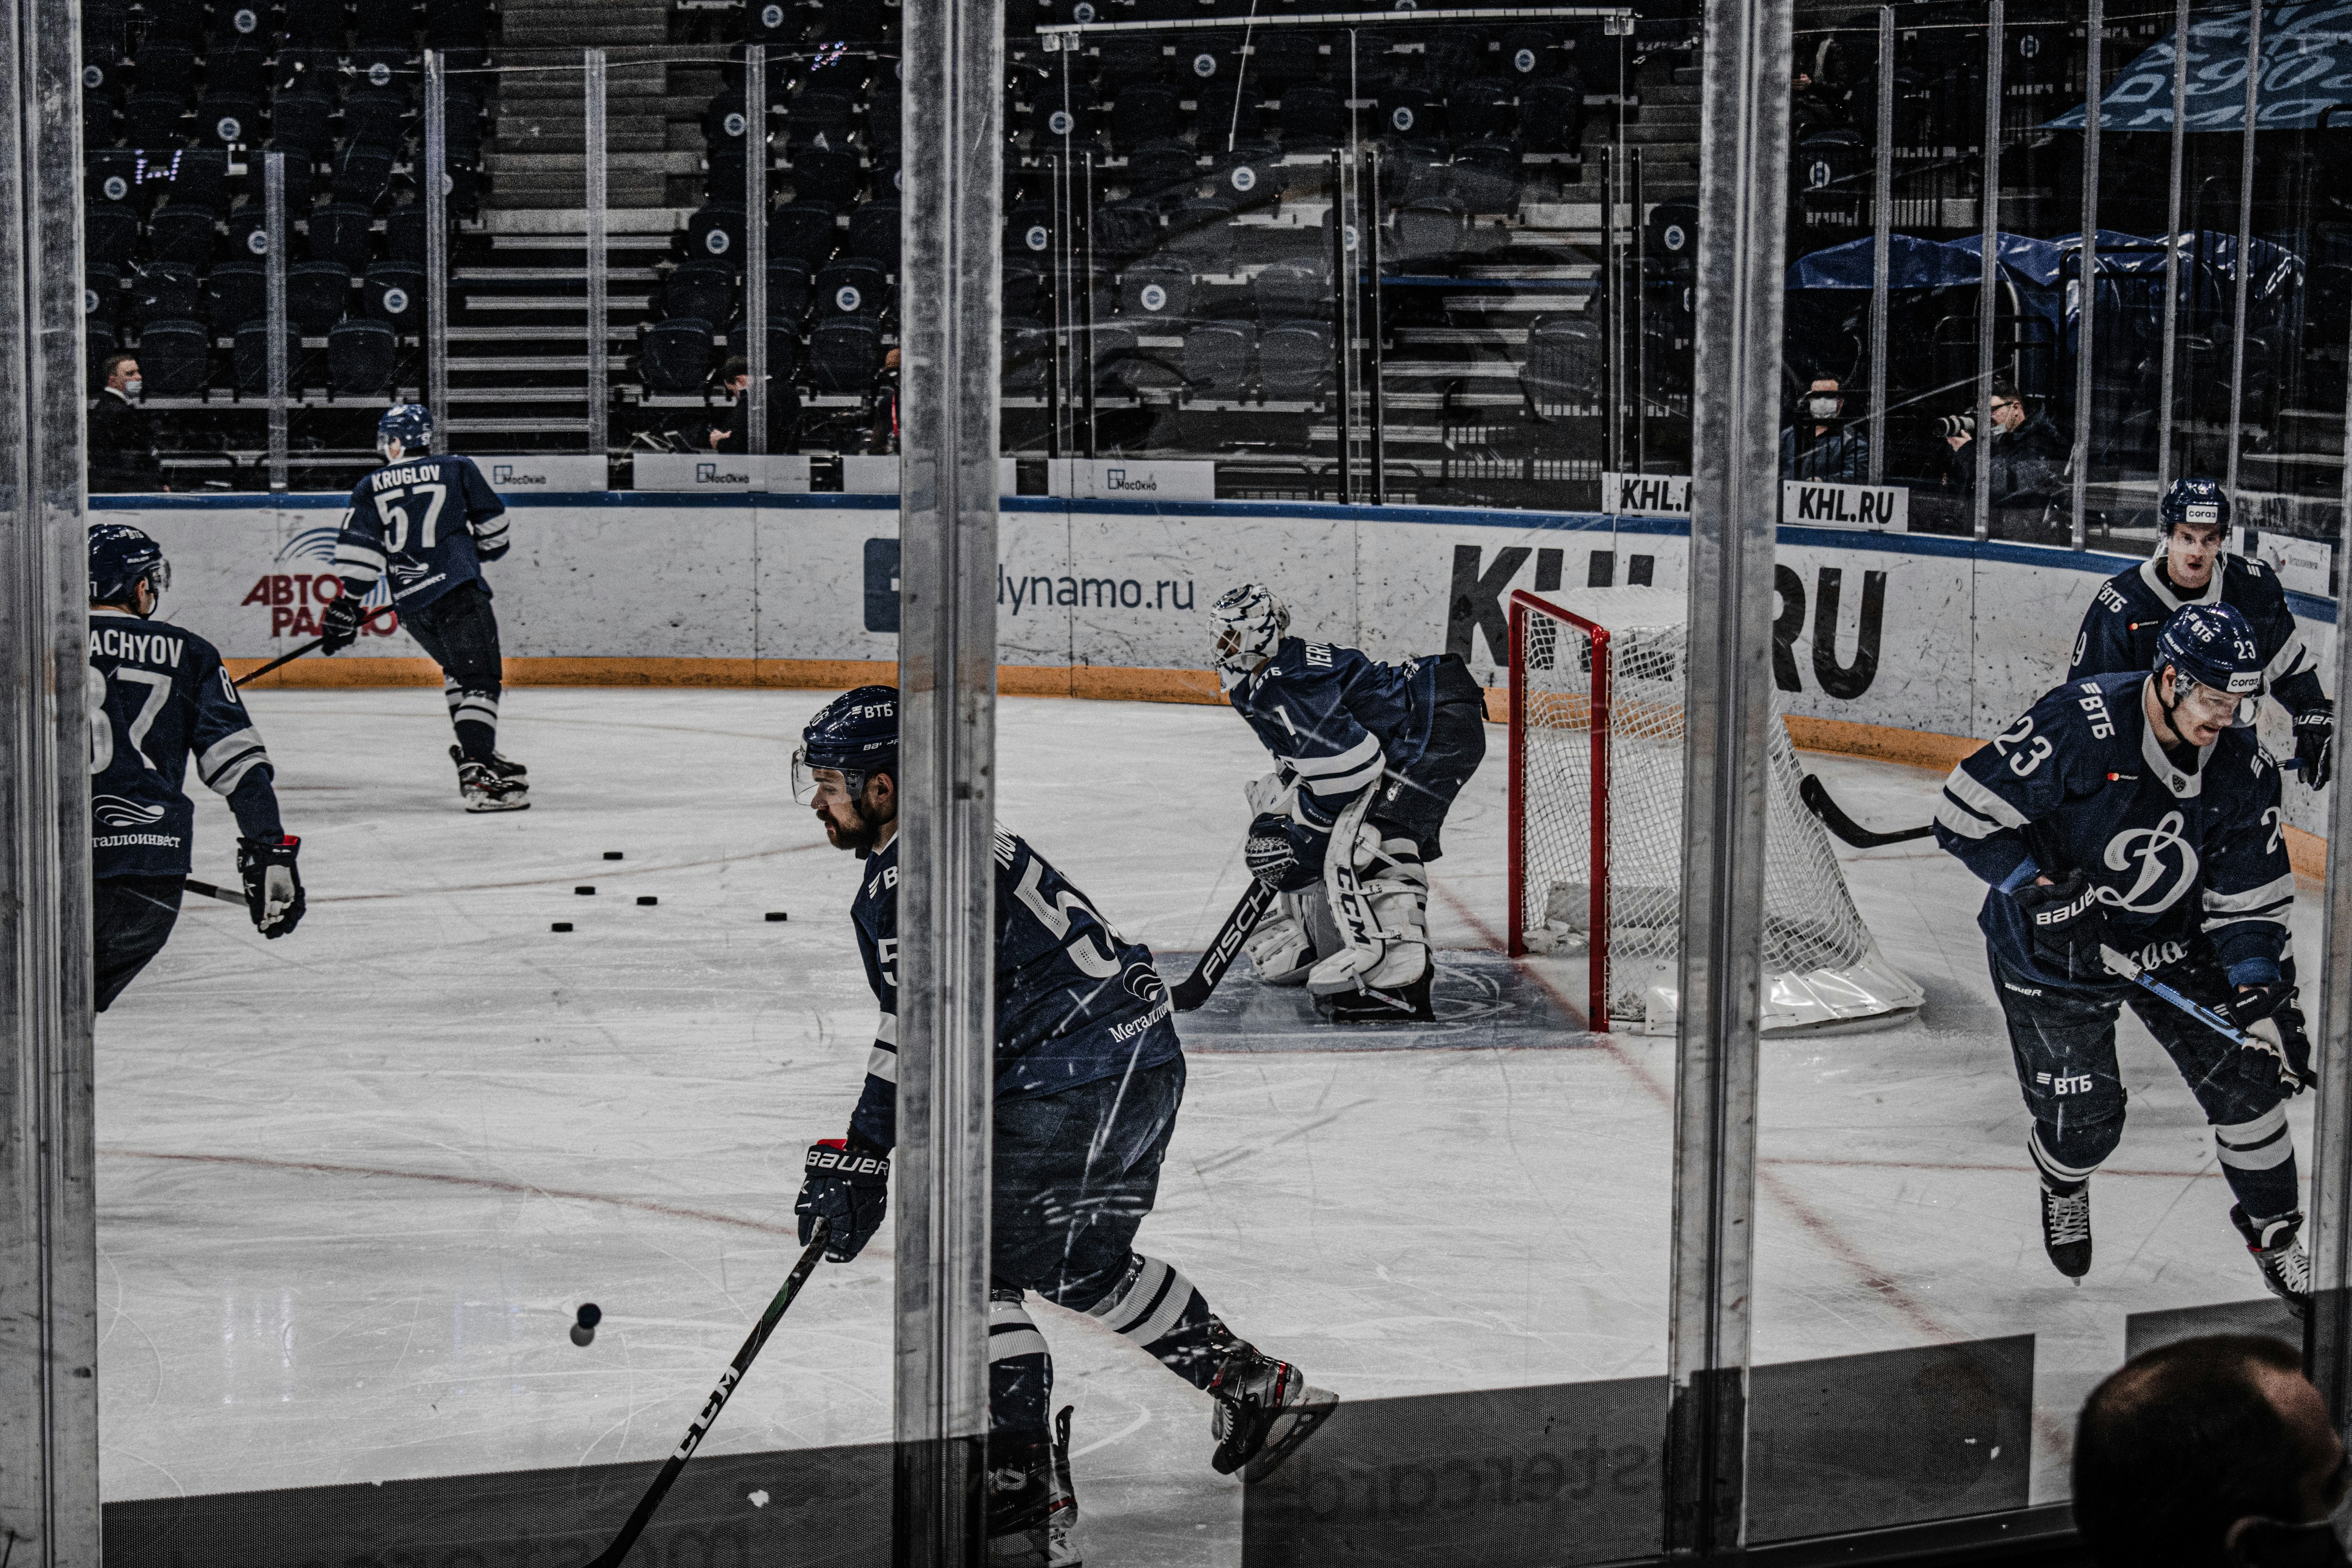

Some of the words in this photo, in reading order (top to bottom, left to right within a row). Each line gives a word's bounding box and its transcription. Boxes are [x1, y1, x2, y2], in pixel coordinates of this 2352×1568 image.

[372, 465, 440, 492] KRUGLOV
[1117, 480, 1157, 491] МосОкно
[374, 483, 447, 553] 57
[1798, 487, 1895, 524] KHL.RU
[241, 574, 344, 606] АВТО
[2098, 587, 2128, 613] ВТБ
[272, 606, 398, 638] РАО
[2190, 620, 2215, 642] ВТБ
[2233, 640, 2256, 659] 23
[1256, 667, 1283, 690] ВТБ
[864, 704, 893, 719] ВТБ
[2079, 696, 2115, 739] ВТБ
[1993, 716, 2053, 777] 23
[1337, 866, 1371, 945] CCM
[2004, 983, 2042, 996] BAUER
[2054, 1074, 2093, 1095] ВТБ
[806, 1151, 890, 1176] BAUER
[671, 1365, 740, 1461] CCM
